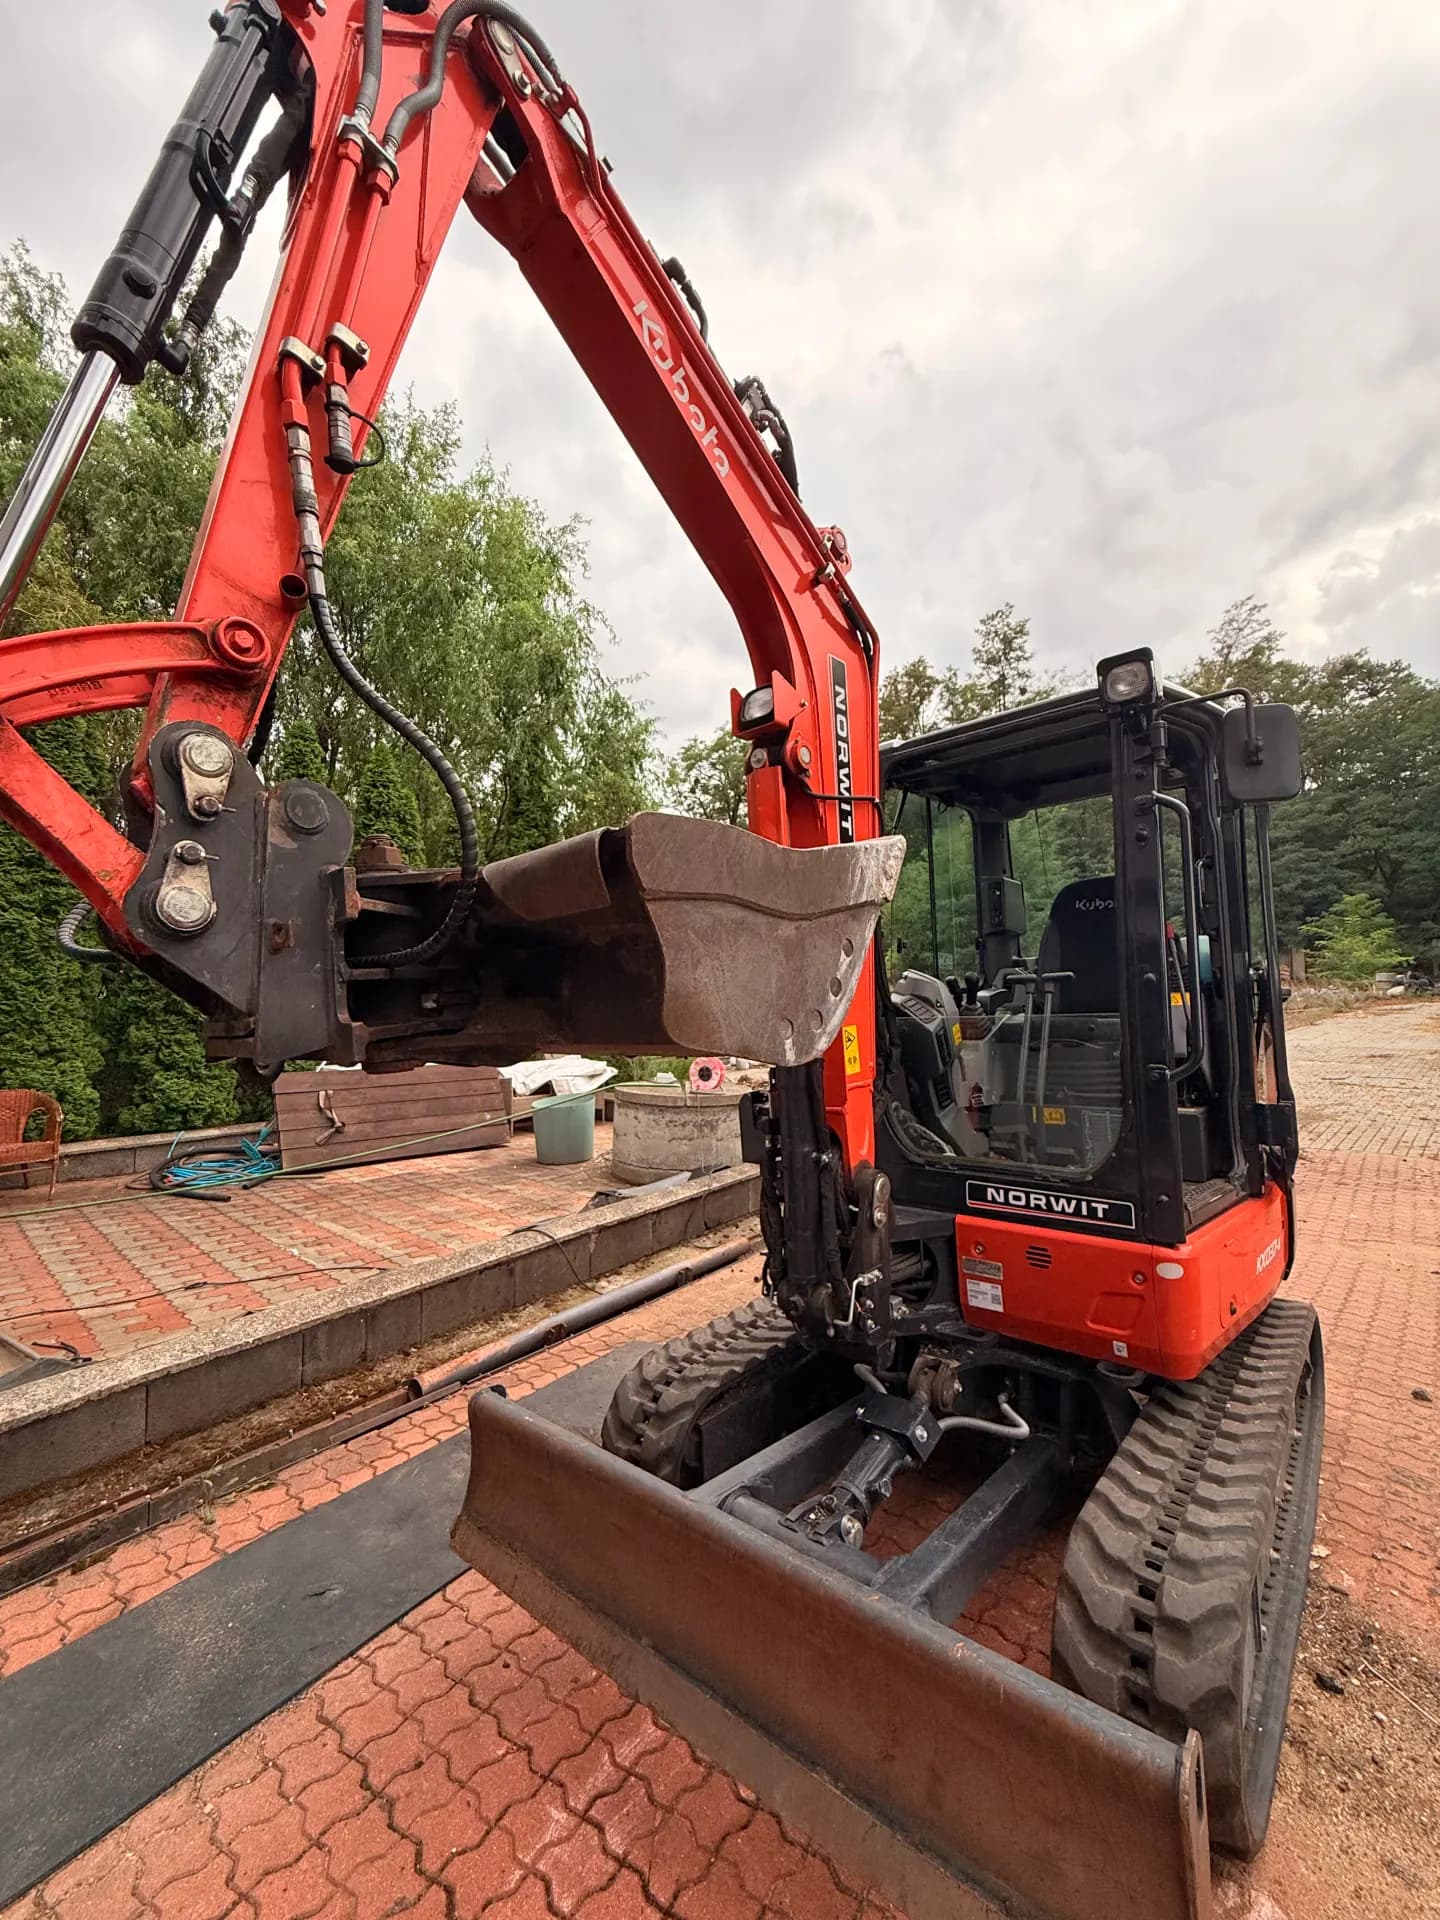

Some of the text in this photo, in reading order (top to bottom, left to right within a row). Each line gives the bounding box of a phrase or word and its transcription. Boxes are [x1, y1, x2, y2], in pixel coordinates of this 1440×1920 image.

[633, 301, 730, 478] Kubota
[834, 684, 853, 836] NORWIT
[1075, 898, 1115, 911] Kubo
[987, 1187, 1109, 1219] NORWIT
